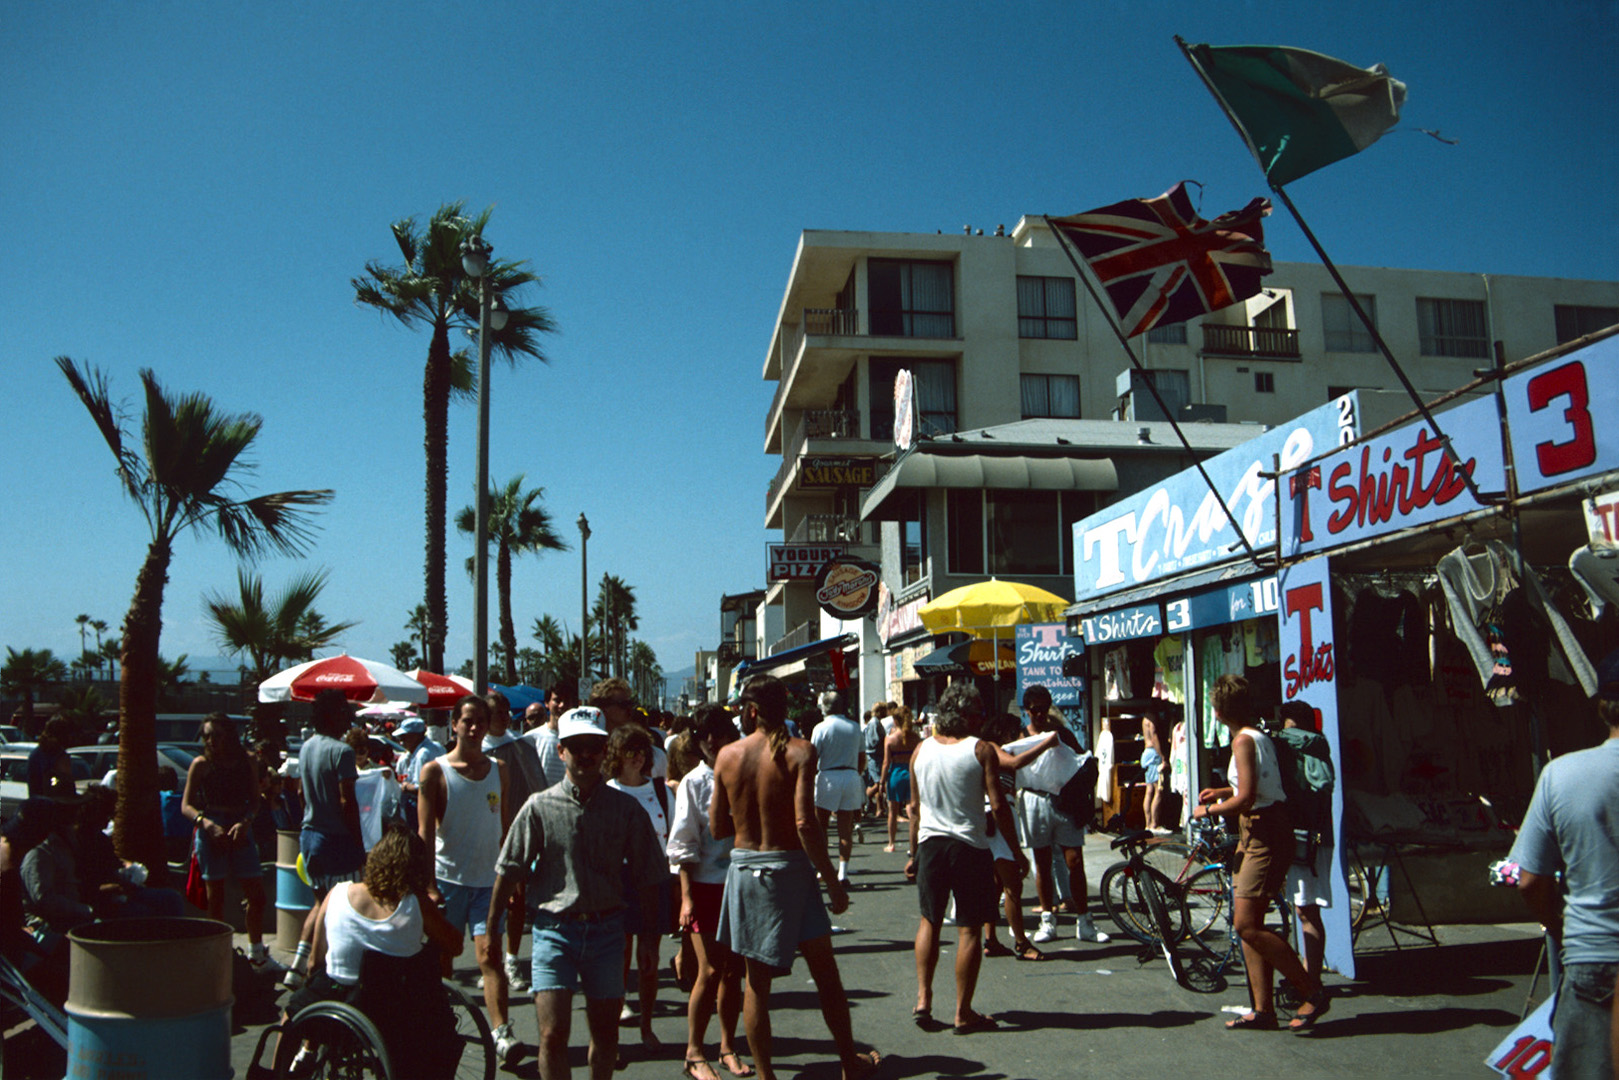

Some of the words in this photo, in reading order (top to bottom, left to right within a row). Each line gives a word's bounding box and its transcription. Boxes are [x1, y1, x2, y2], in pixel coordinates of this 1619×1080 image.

[1527, 360, 1597, 477] 3
[805, 467, 872, 484] SAUSAGE
[774, 549, 842, 562] YOGURT
[1166, 598, 1190, 631] 3
[1229, 591, 1247, 621] for
[1032, 625, 1066, 647] T
[923, 663, 965, 674] CINZANO
[1022, 667, 1046, 676] TANK
[1049, 689, 1080, 703] izes!
[1493, 1034, 1553, 1080] 10
